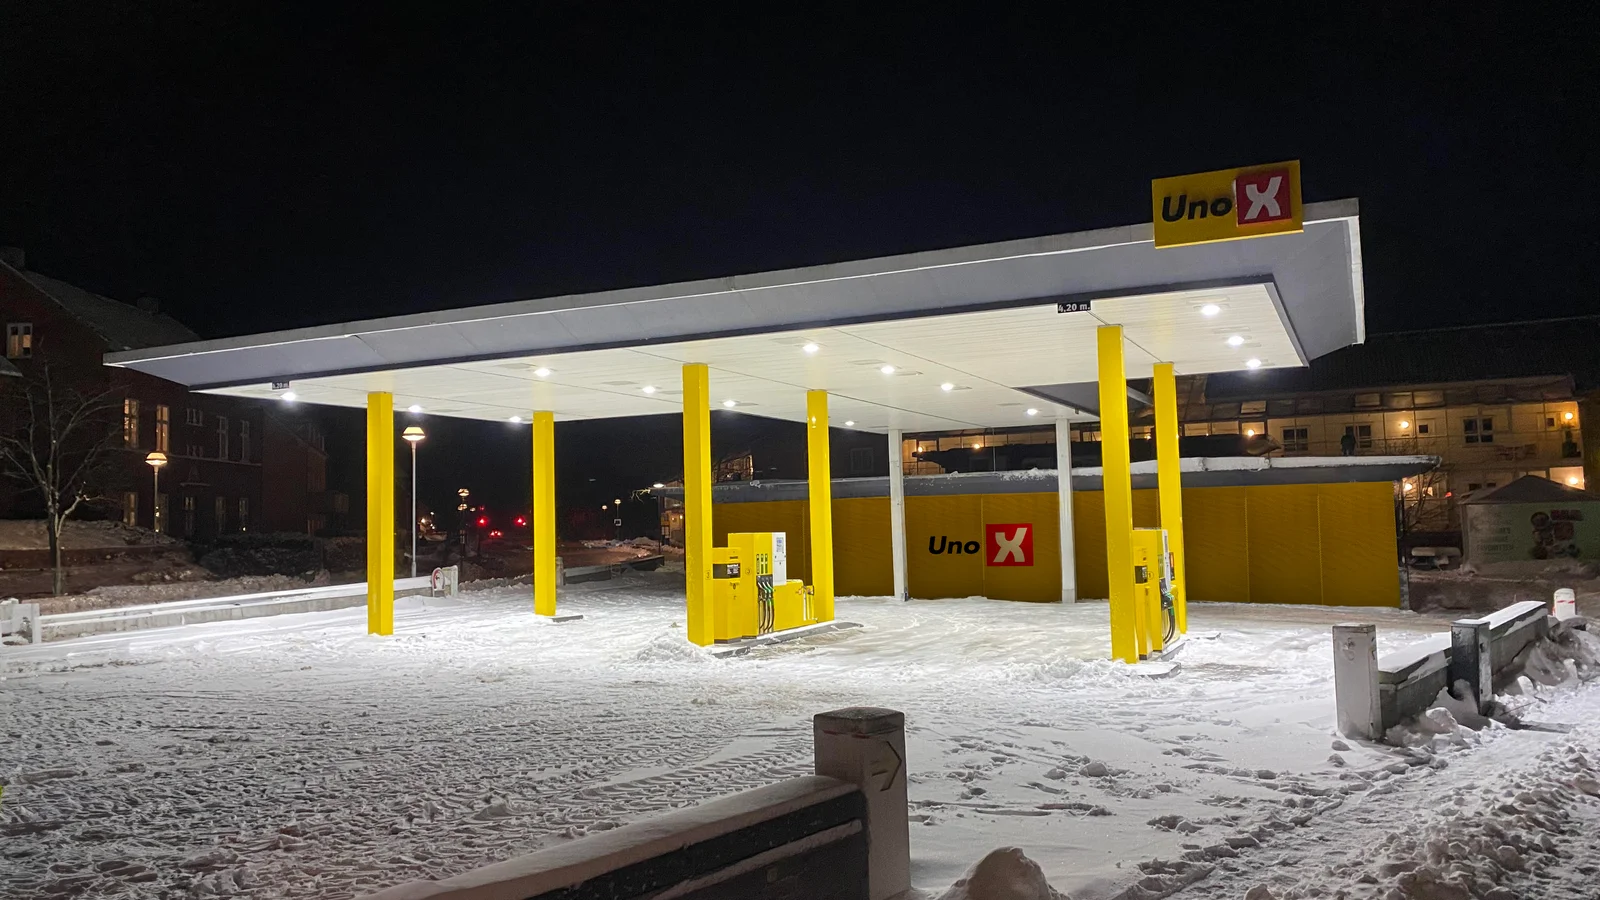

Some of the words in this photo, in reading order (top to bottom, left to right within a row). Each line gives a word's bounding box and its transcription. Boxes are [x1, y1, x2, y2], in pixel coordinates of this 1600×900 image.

[1162, 194, 1232, 222] Uno
[1244, 176, 1283, 220] X
[928, 536, 980, 555] Uno
[993, 527, 1028, 563] X
